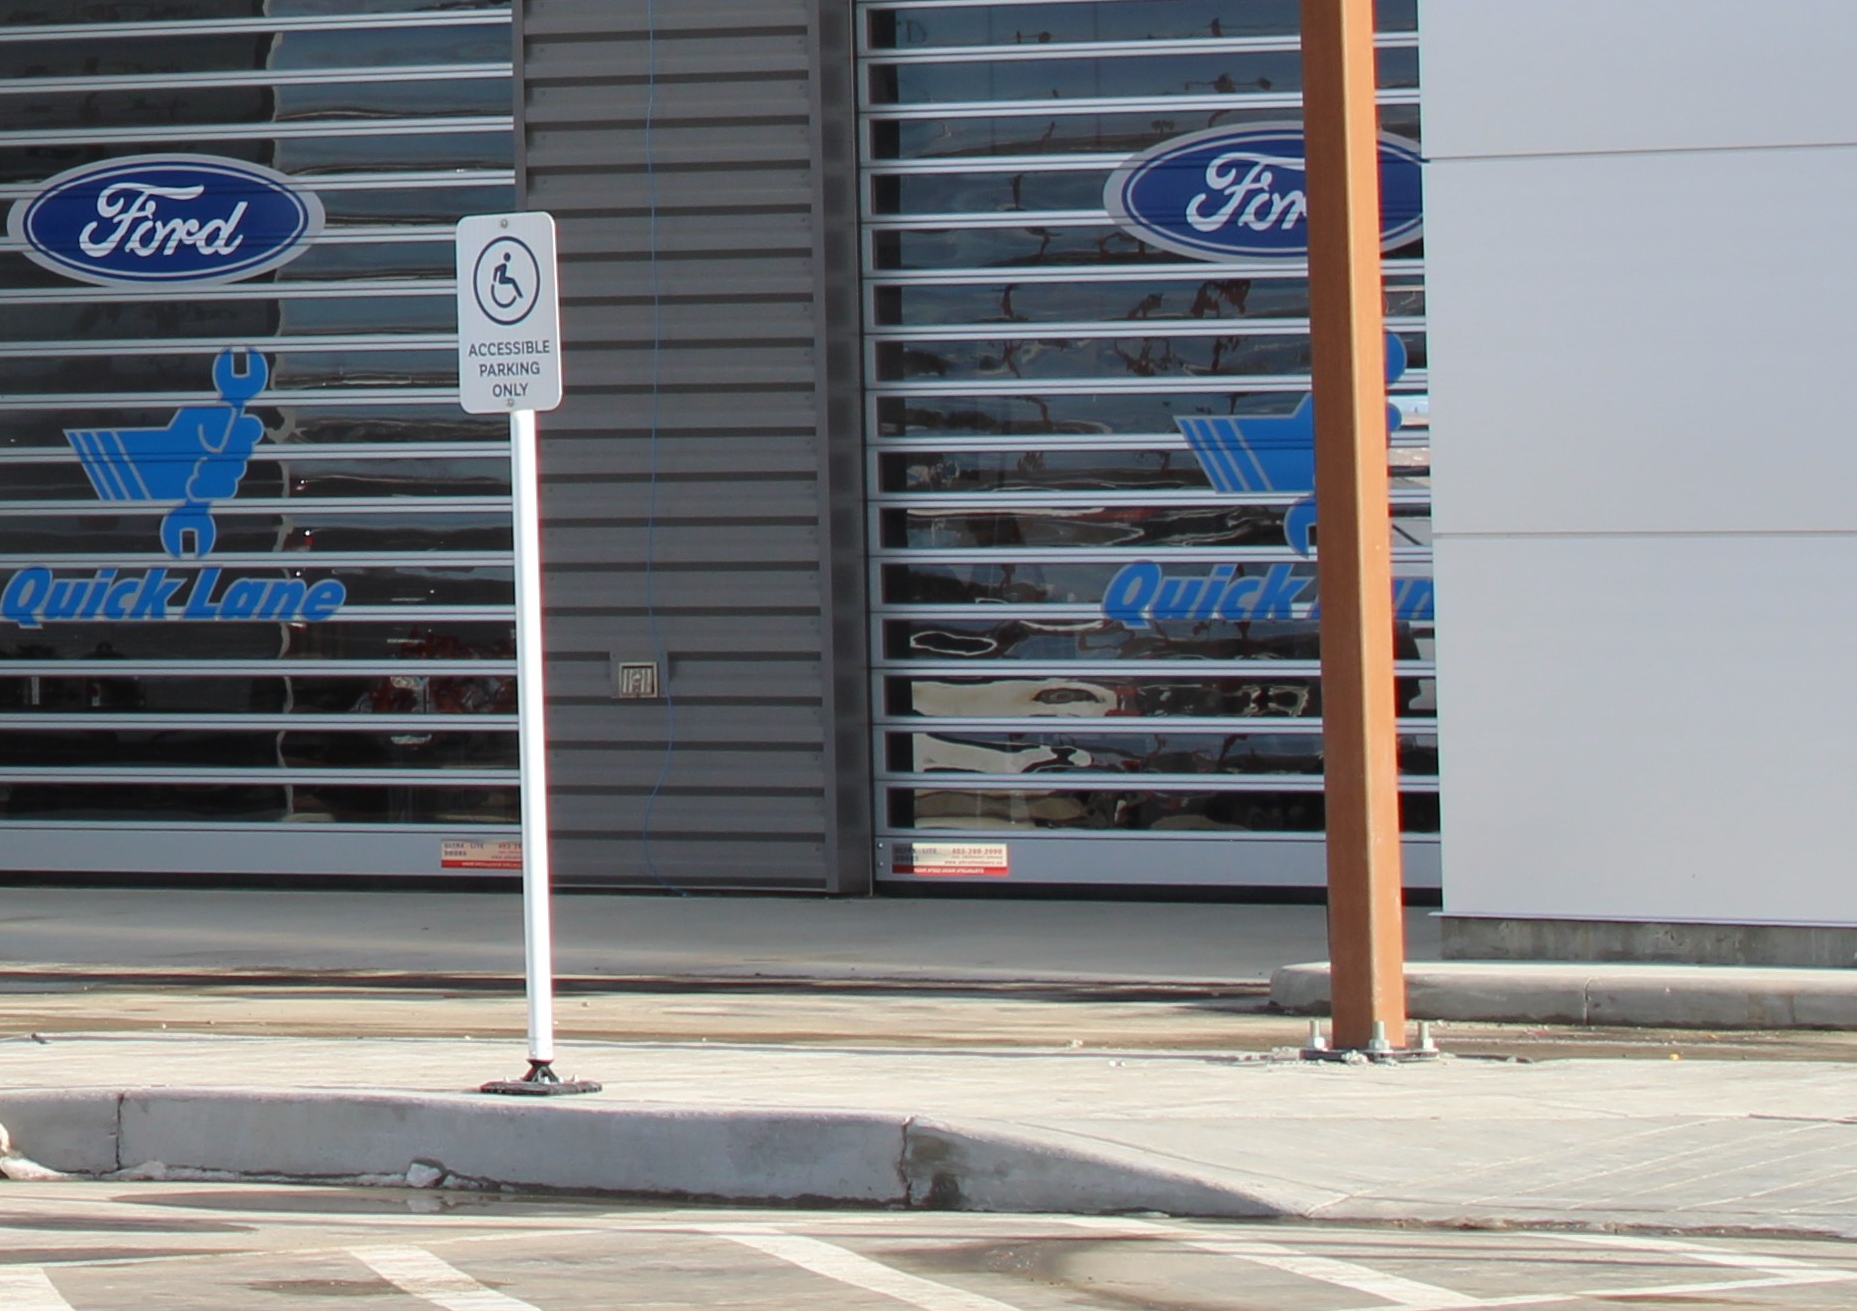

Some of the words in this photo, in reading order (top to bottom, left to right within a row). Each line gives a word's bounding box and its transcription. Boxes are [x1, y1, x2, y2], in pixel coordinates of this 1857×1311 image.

[79, 182, 248, 257] Ford
[1186, 151, 1307, 233] For
[469, 339, 550, 357] ACCESSIBLE
[479, 362, 540, 377] PARKING
[492, 383, 529, 397] ONLY
[0, 566, 188, 628] Quick
[183, 567, 346, 621] Lane
[1101, 560, 1317, 628] Quick
